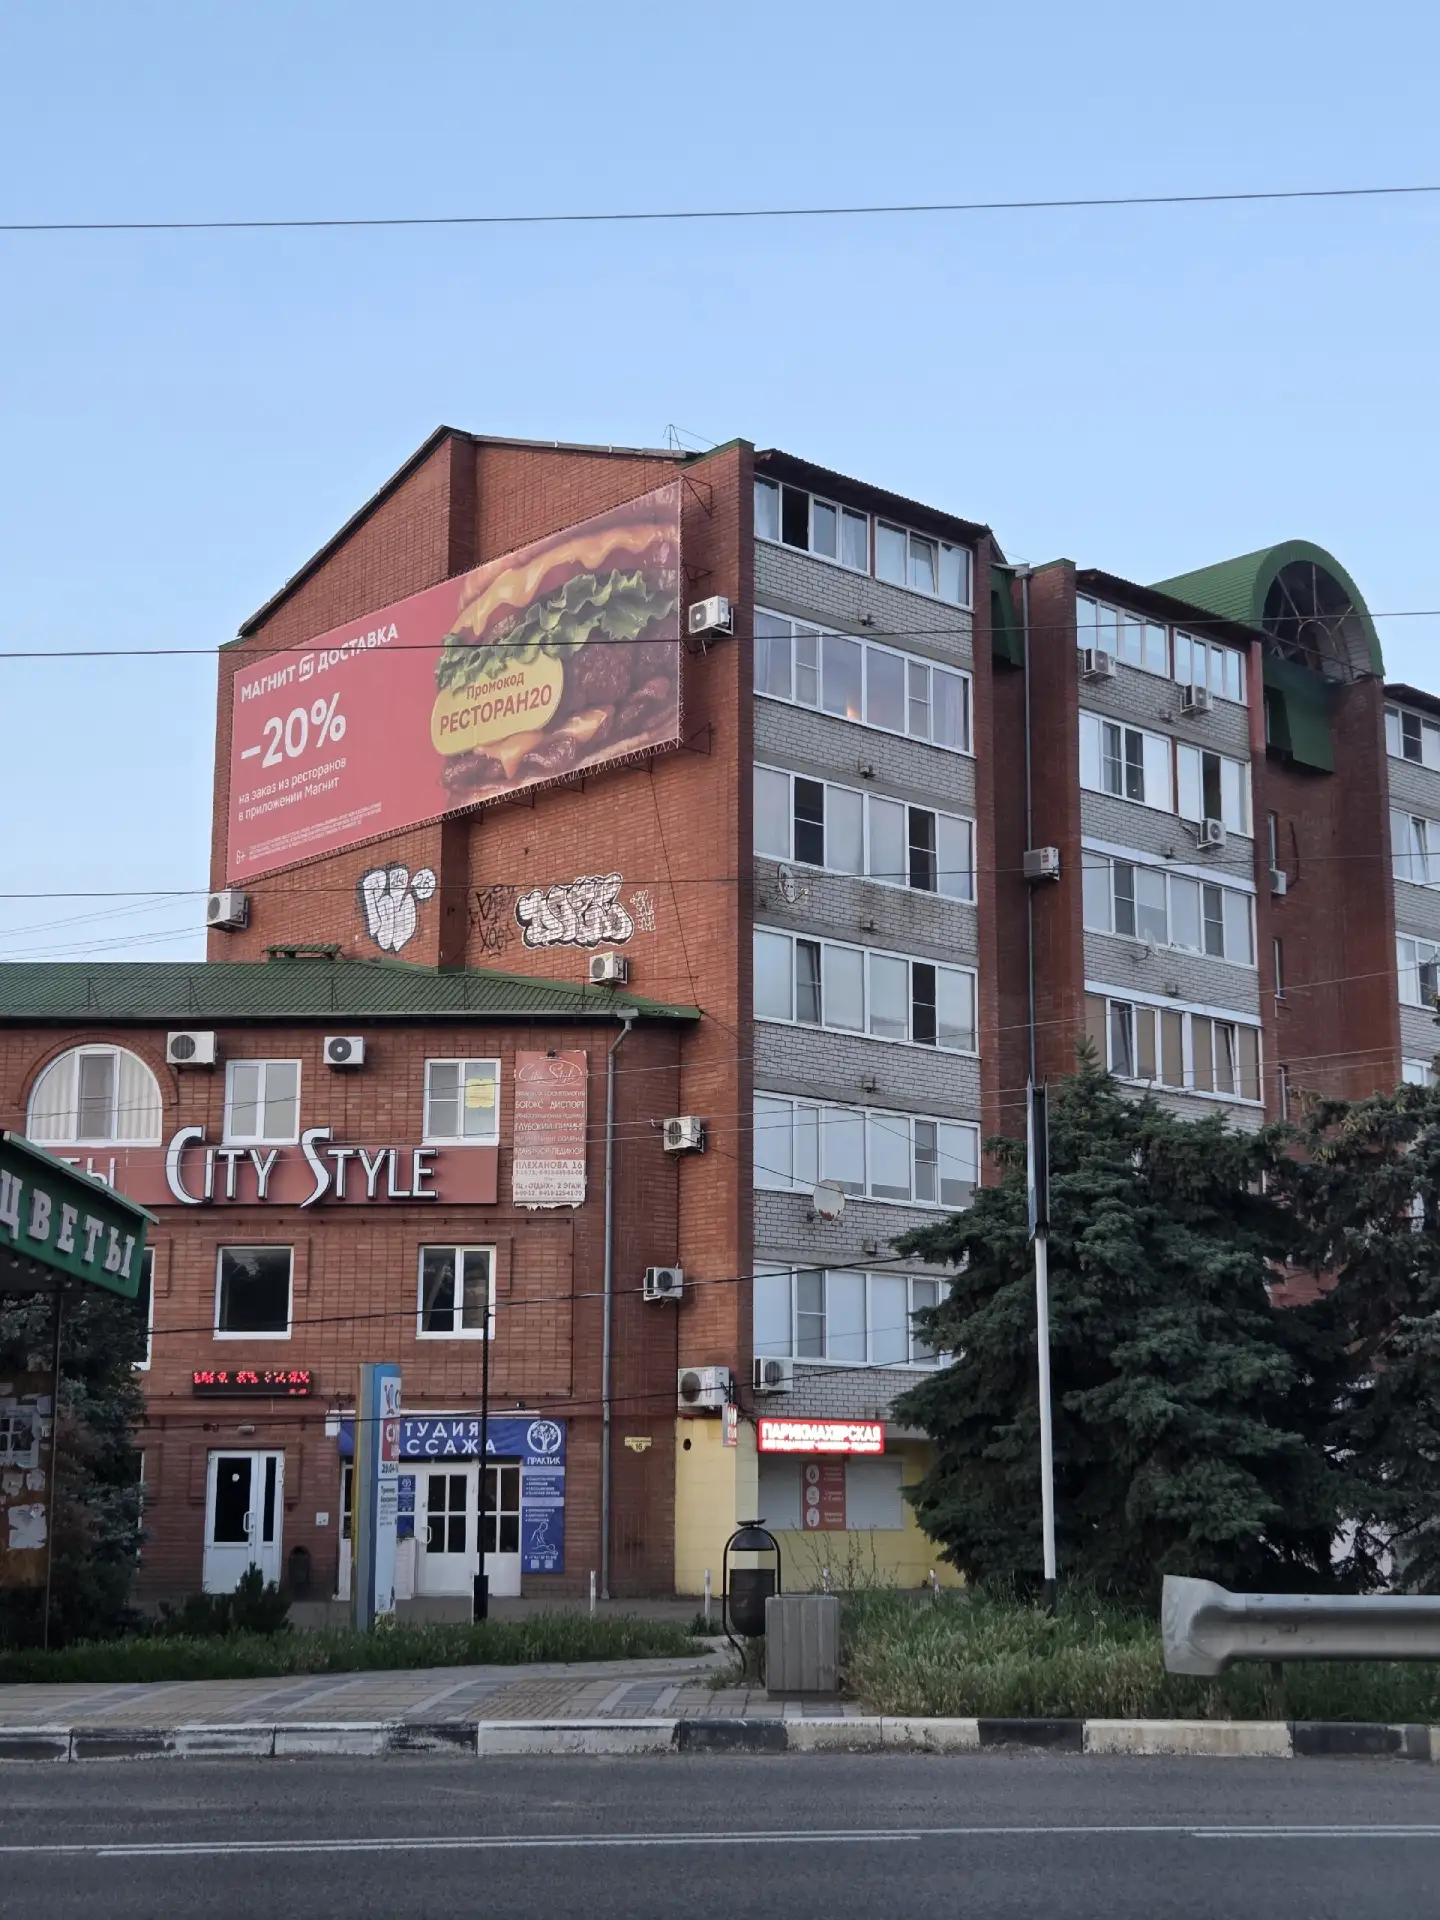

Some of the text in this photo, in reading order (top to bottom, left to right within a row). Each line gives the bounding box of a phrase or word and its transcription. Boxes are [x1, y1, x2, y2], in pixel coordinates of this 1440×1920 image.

[241, 665, 296, 702] МАГНИТ
[318, 623, 399, 673] ДОСТАВКА
[466, 672, 525, 700] Промокод
[440, 684, 552, 735] РЕСТОРАН20
[238, 777, 340, 821] в приложении Магнит
[239, 757, 347, 805] на заказ из ресторанов
[515, 1100, 585, 1110] БОТОКС ДИСПОРТ
[165, 1125, 439, 1209] CITY STYLE
[516, 1161, 583, 1169] ПЛЕХАНОВА 16
[0, 1168, 136, 1279] ЦВЕТЫ
[404, 1422, 480, 1438] ТУДИЯ
[405, 1438, 497, 1455] ССАЖА
[527, 1456, 561, 1465] ПРАКТИК
